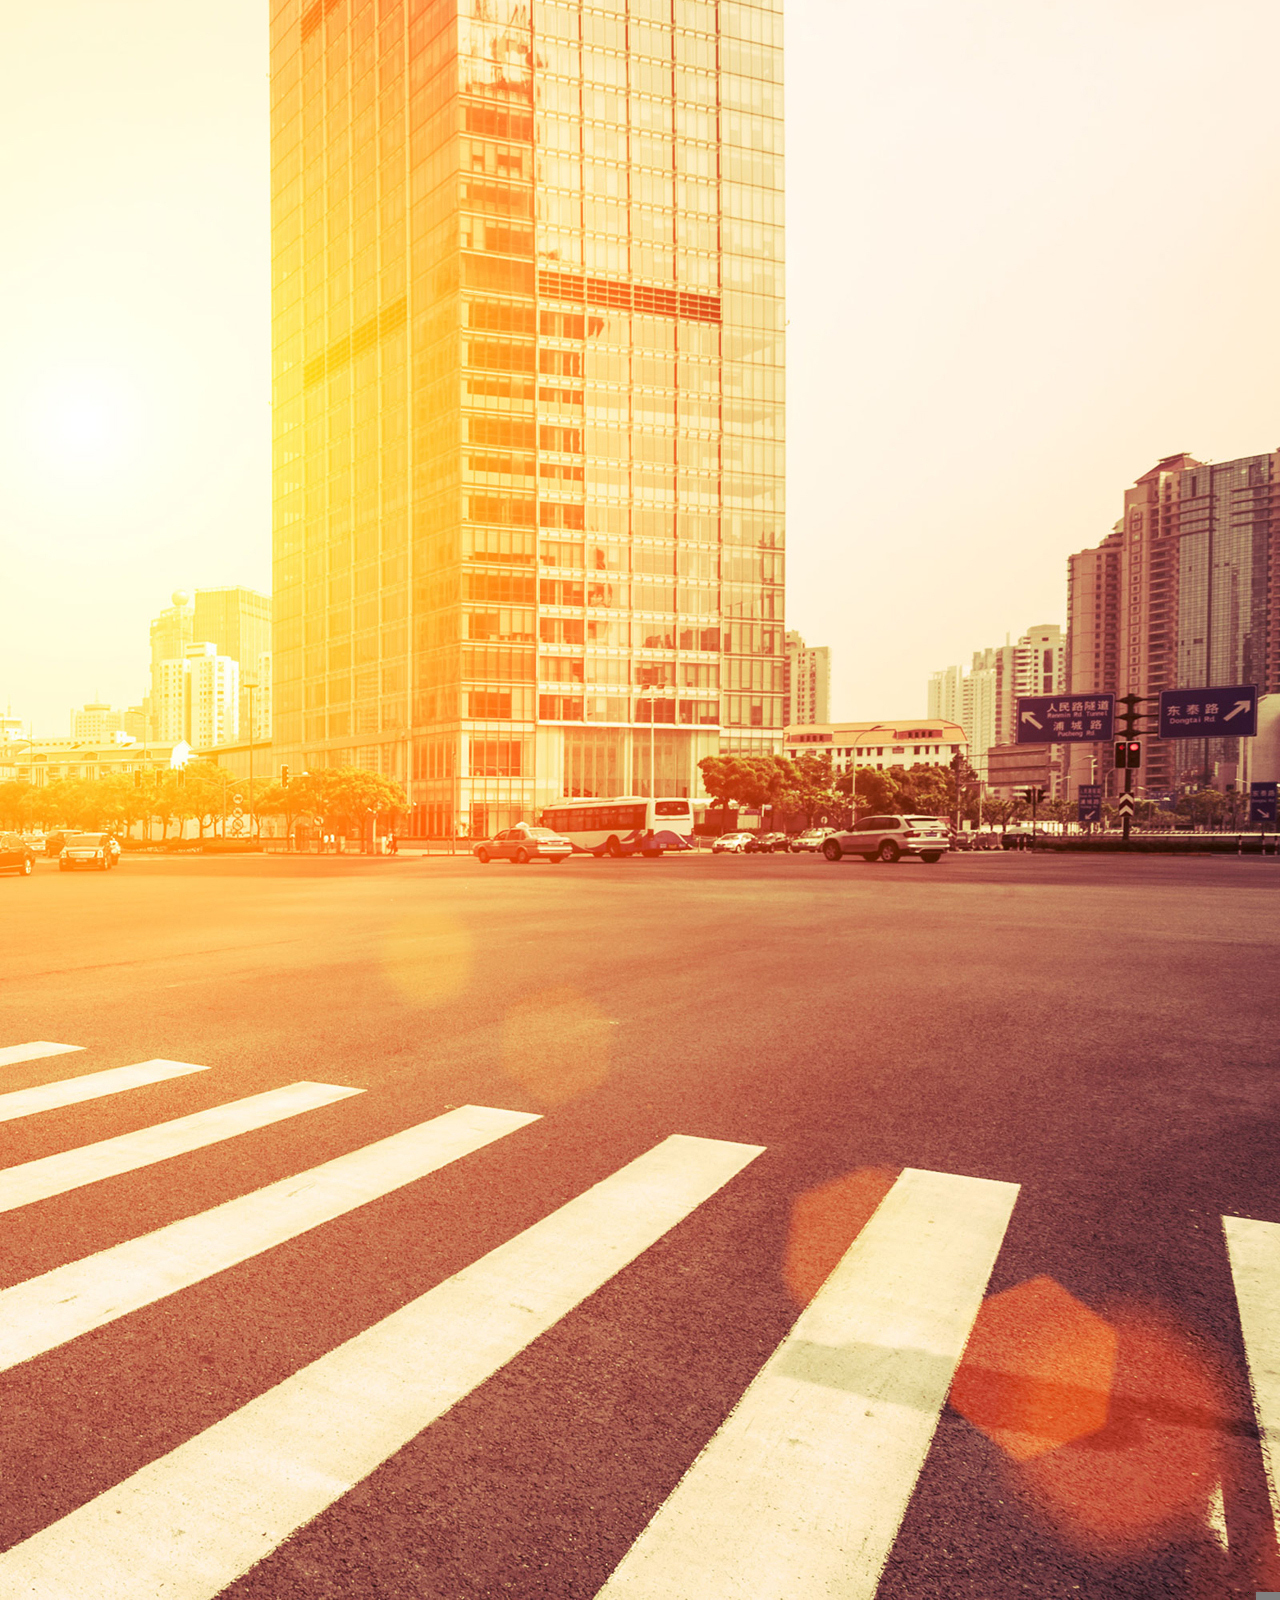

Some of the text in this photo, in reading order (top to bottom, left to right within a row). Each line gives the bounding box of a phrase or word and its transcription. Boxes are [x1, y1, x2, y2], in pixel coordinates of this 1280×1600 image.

[1046, 700, 1109, 713] 人民路隧道
[1166, 703, 1219, 716] 东泰路
[1053, 719, 1102, 731] 浦城路
[1169, 716, 1201, 725] Dongtai
